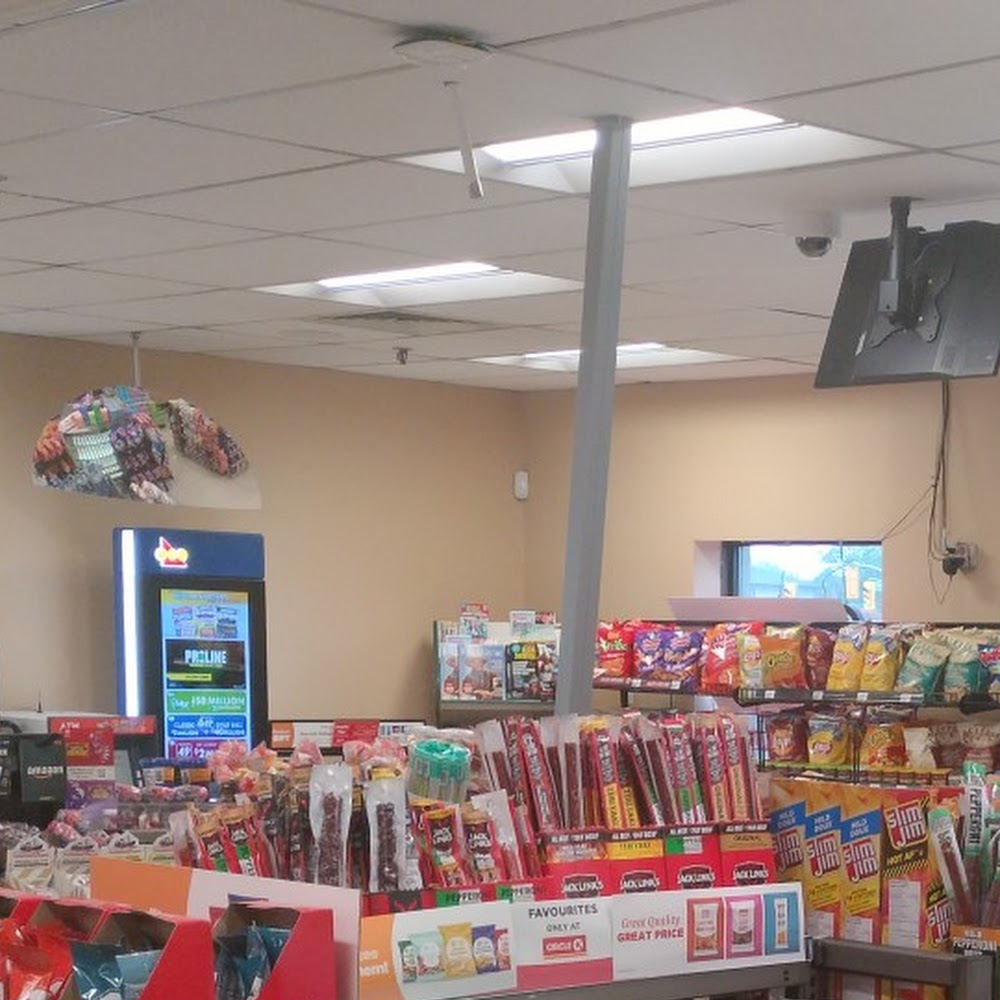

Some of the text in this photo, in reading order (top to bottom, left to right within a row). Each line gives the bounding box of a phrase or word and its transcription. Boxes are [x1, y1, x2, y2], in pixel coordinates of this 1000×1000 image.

[185, 650, 227, 664] PROLINE
[27, 766, 63, 775] amazon
[529, 904, 597, 919] FAVOURITES
[546, 922, 581, 932] ONLY AT
[617, 927, 684, 943] GREAT PRICE
[546, 942, 571, 951] CIRCLE
